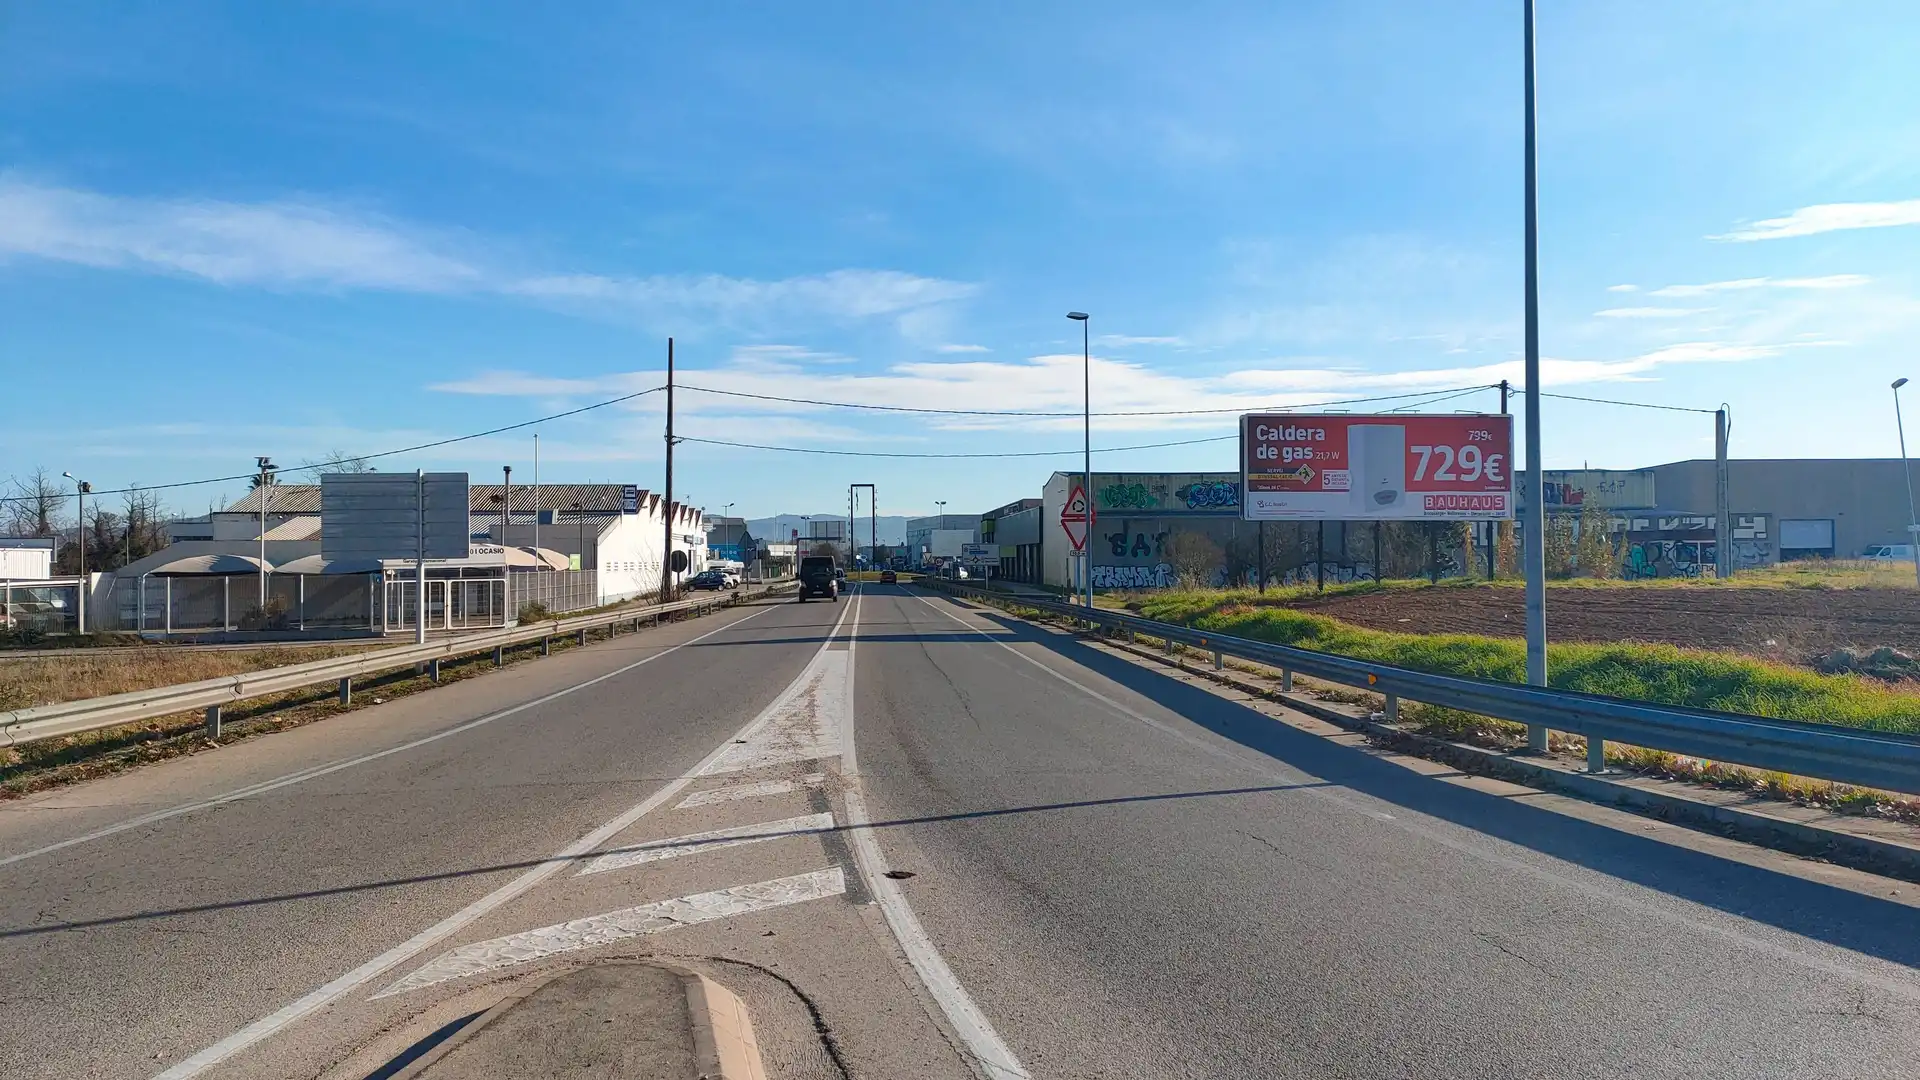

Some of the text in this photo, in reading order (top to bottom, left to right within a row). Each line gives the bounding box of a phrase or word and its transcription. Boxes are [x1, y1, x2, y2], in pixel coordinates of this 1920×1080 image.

[1256, 425, 1325, 441] Caldera
[1256, 444, 1279, 459] de
[1282, 446, 1314, 463] gas
[1410, 445, 1505, 481] 729€
[1323, 474, 1331, 486] 5
[1424, 495, 1505, 510] BAUHAUS
